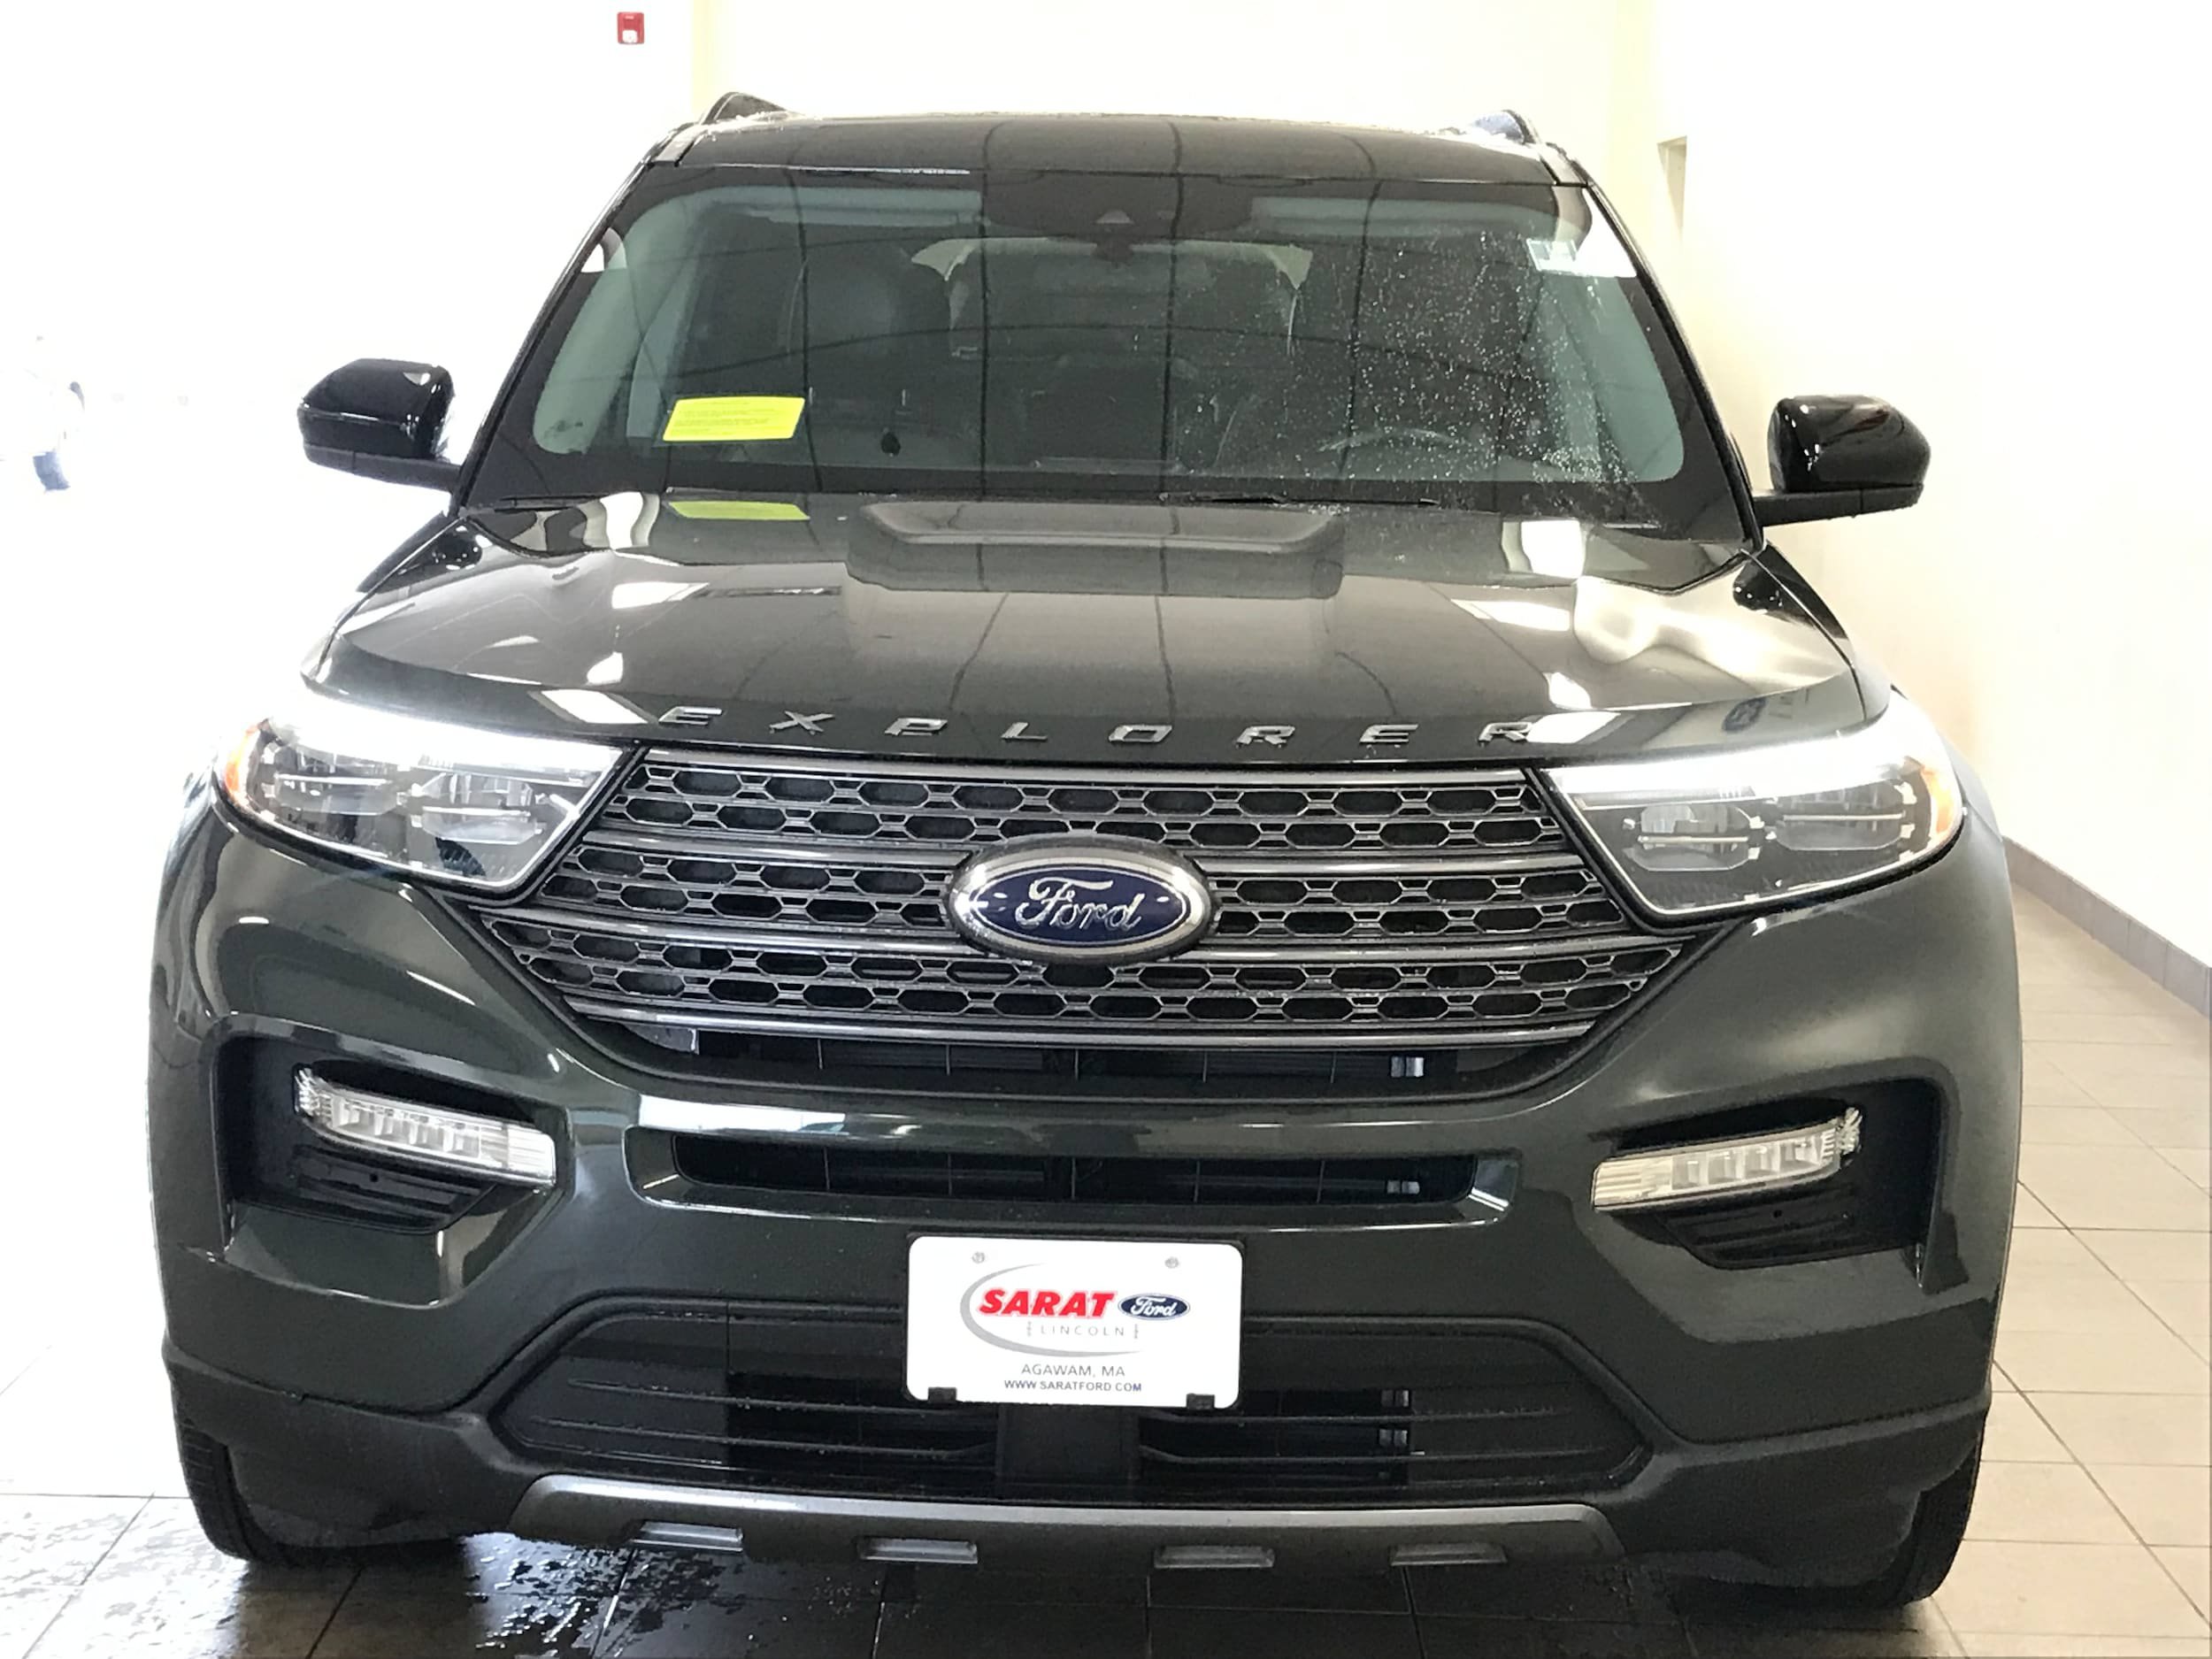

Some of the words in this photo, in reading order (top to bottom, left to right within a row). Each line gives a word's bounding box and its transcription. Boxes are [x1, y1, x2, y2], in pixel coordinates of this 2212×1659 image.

[659, 706, 1534, 748] EXPLORER
[1015, 876, 1145, 931] Ford
[979, 1288, 1116, 1317] SARAT
[1130, 1295, 1177, 1317] Ford
[1041, 1325, 1125, 1337] LINCOLN
[1021, 1363, 1095, 1378] AGAWAM,
[1102, 1365, 1125, 1377] MA
[1004, 1379, 1142, 1392] WWWSARATFORDCOM
